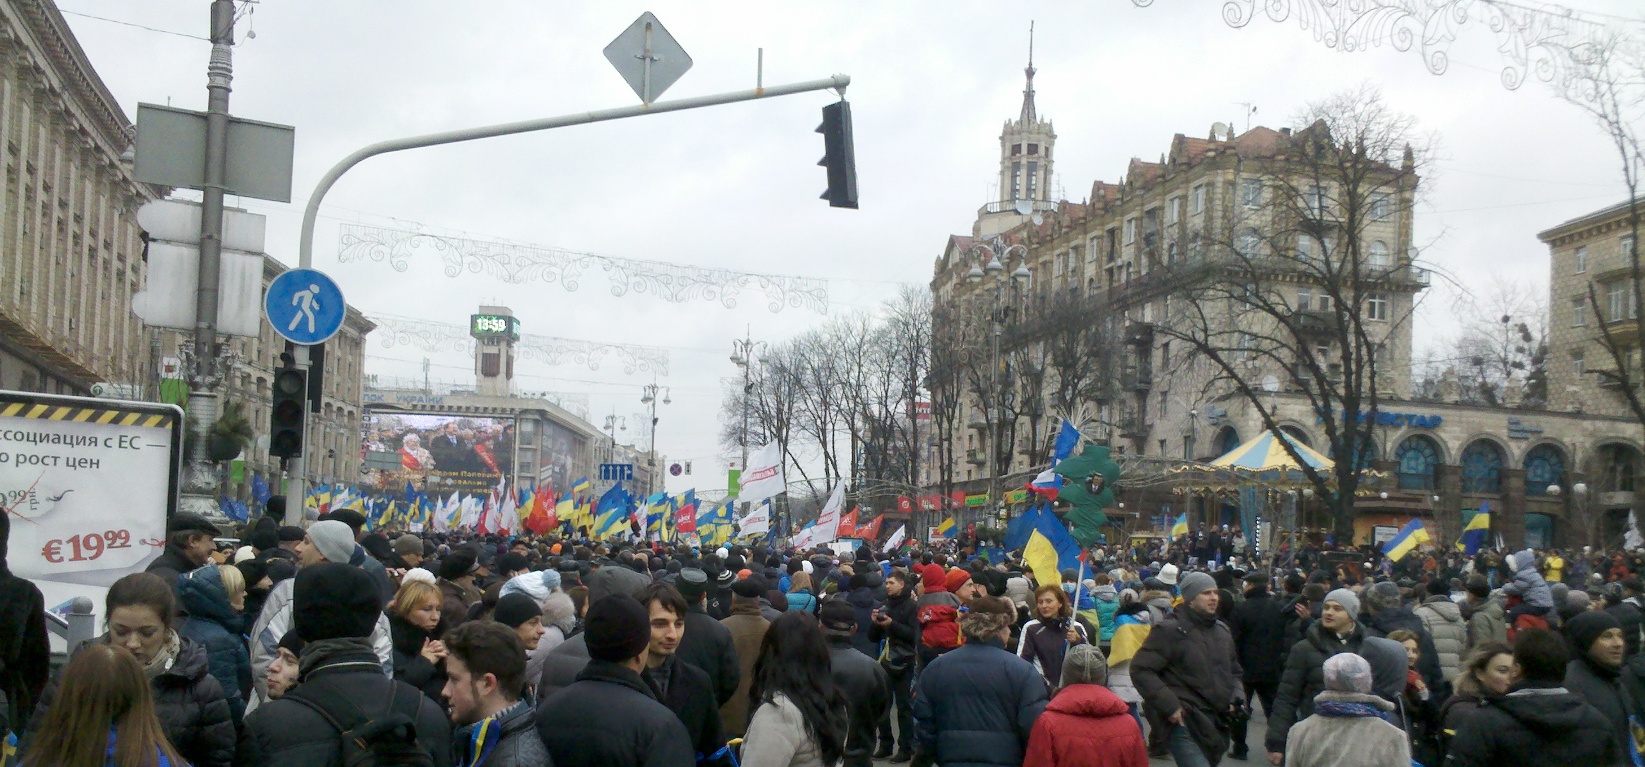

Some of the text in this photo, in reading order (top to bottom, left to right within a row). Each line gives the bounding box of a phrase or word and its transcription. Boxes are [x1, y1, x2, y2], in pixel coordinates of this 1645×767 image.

[476, 318, 507, 332] 13:59
[396, 395, 444, 405] УКРАЇНИ
[0, 429, 98, 448] социация
[104, 436, 113, 448] с
[118, 435, 141, 450] ЕС
[15, 453, 60, 467] рост
[65, 456, 100, 470] цен
